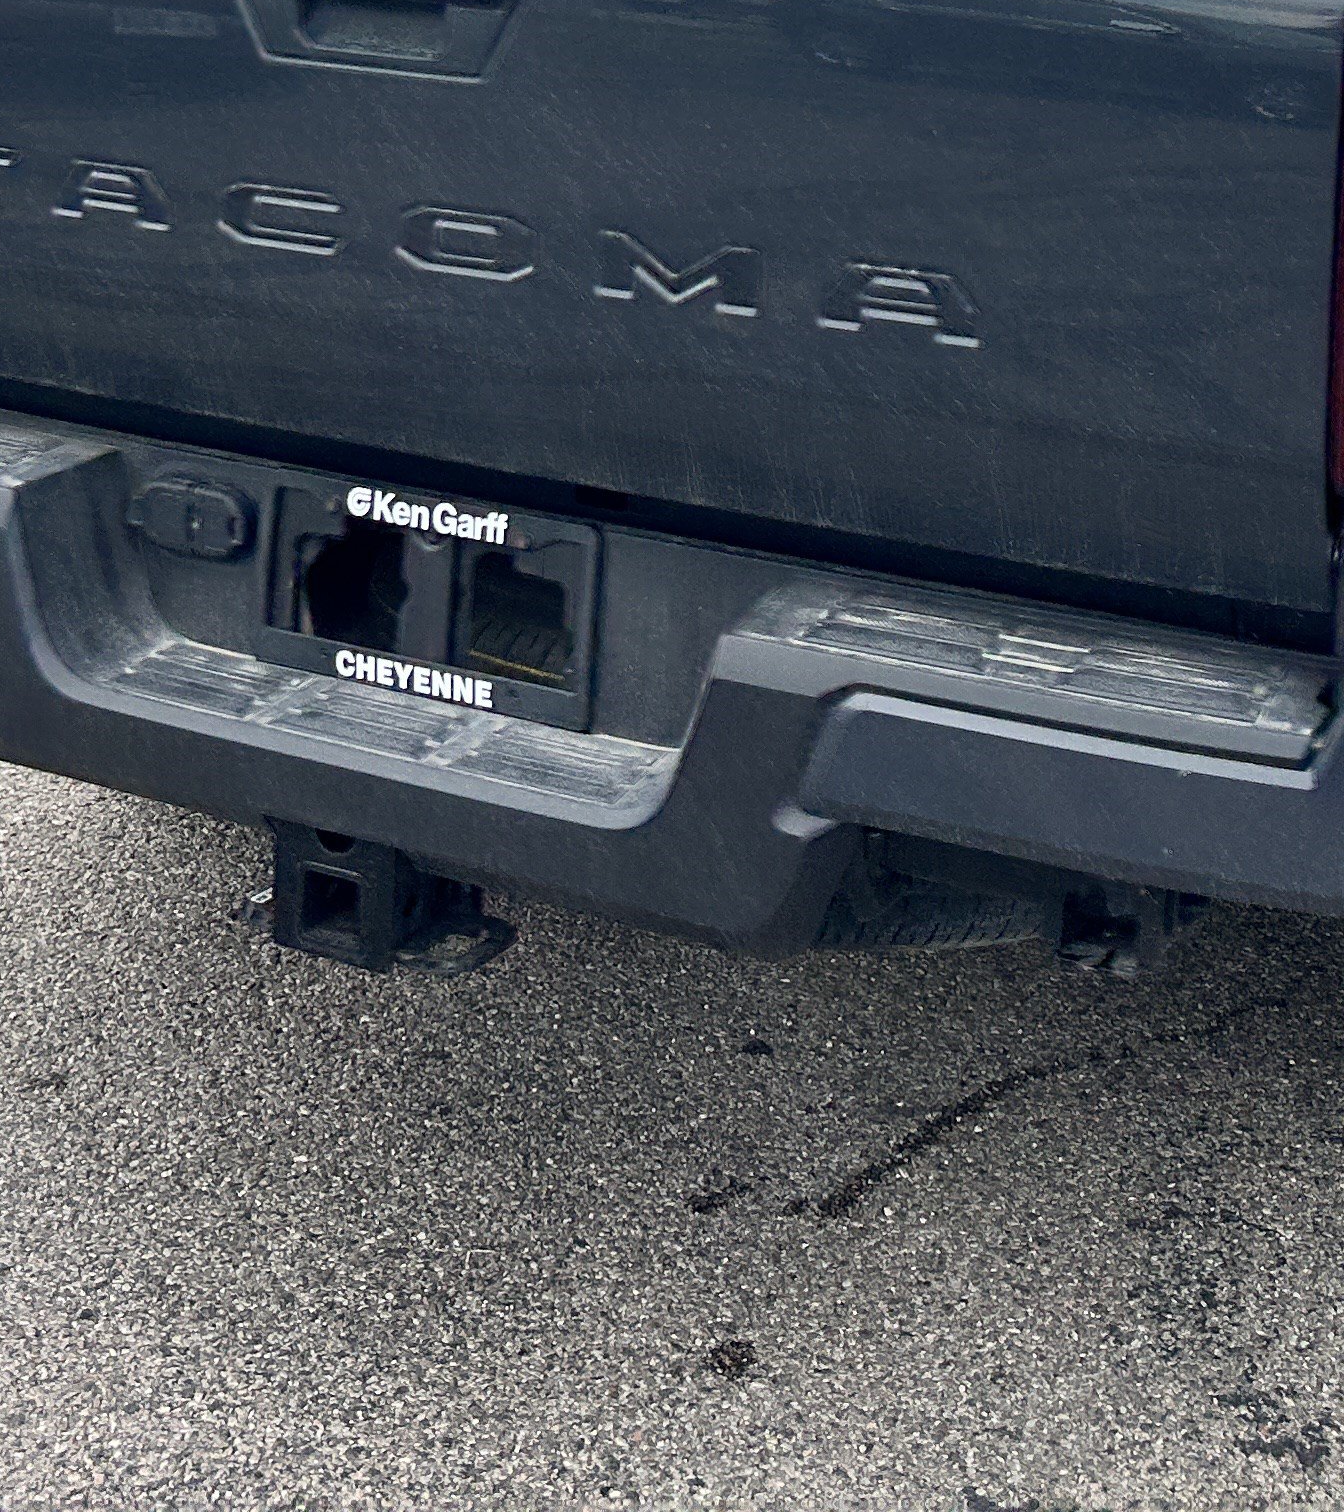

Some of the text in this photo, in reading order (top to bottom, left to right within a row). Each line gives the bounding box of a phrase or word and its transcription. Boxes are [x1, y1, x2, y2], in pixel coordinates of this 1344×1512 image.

[372, 489, 509, 545] Ken Garff
[335, 649, 493, 708] CHEYENNE
